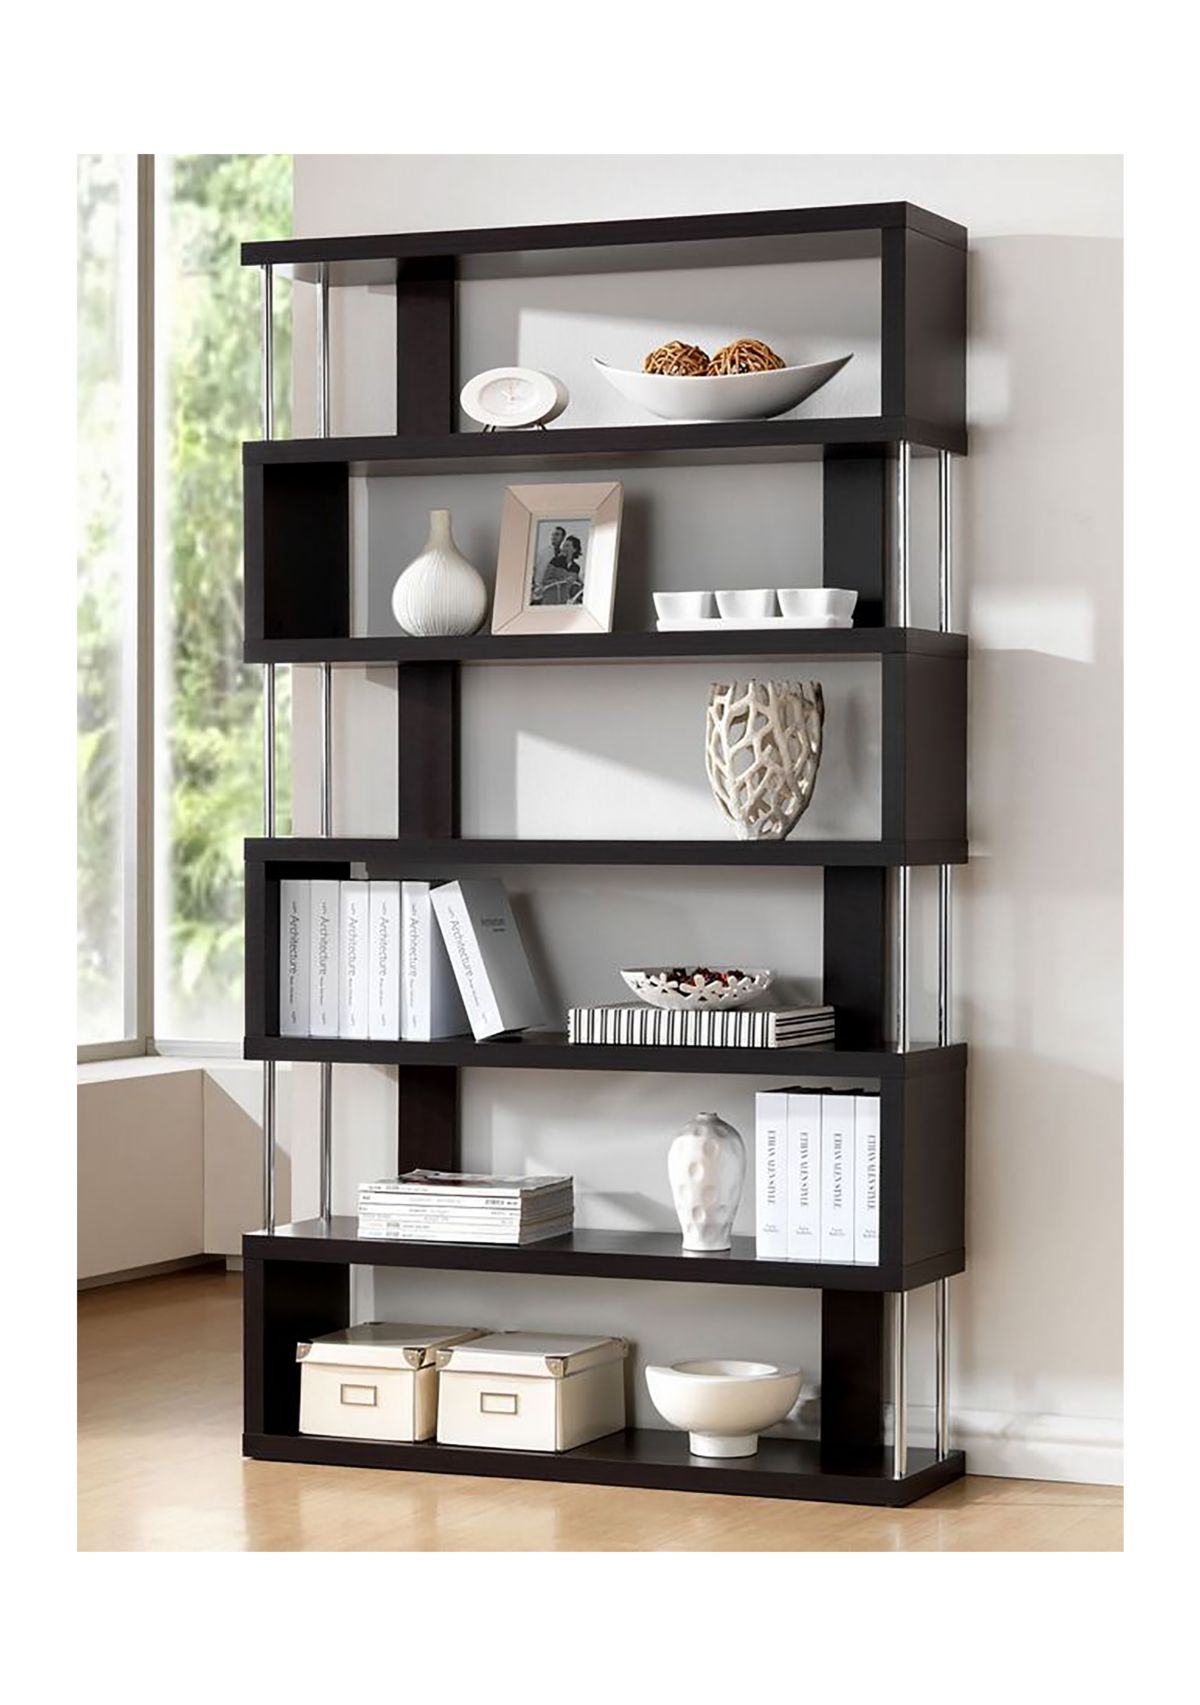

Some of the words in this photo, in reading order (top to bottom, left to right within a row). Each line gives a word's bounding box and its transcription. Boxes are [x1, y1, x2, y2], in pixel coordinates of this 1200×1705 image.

[289, 914, 300, 975] Architecture
[319, 916, 330, 975] Architecture
[348, 916, 358, 977] Architecture
[378, 916, 389, 977] Architecture
[408, 917, 419, 977] Architecture
[449, 919, 474, 977] Architecture
